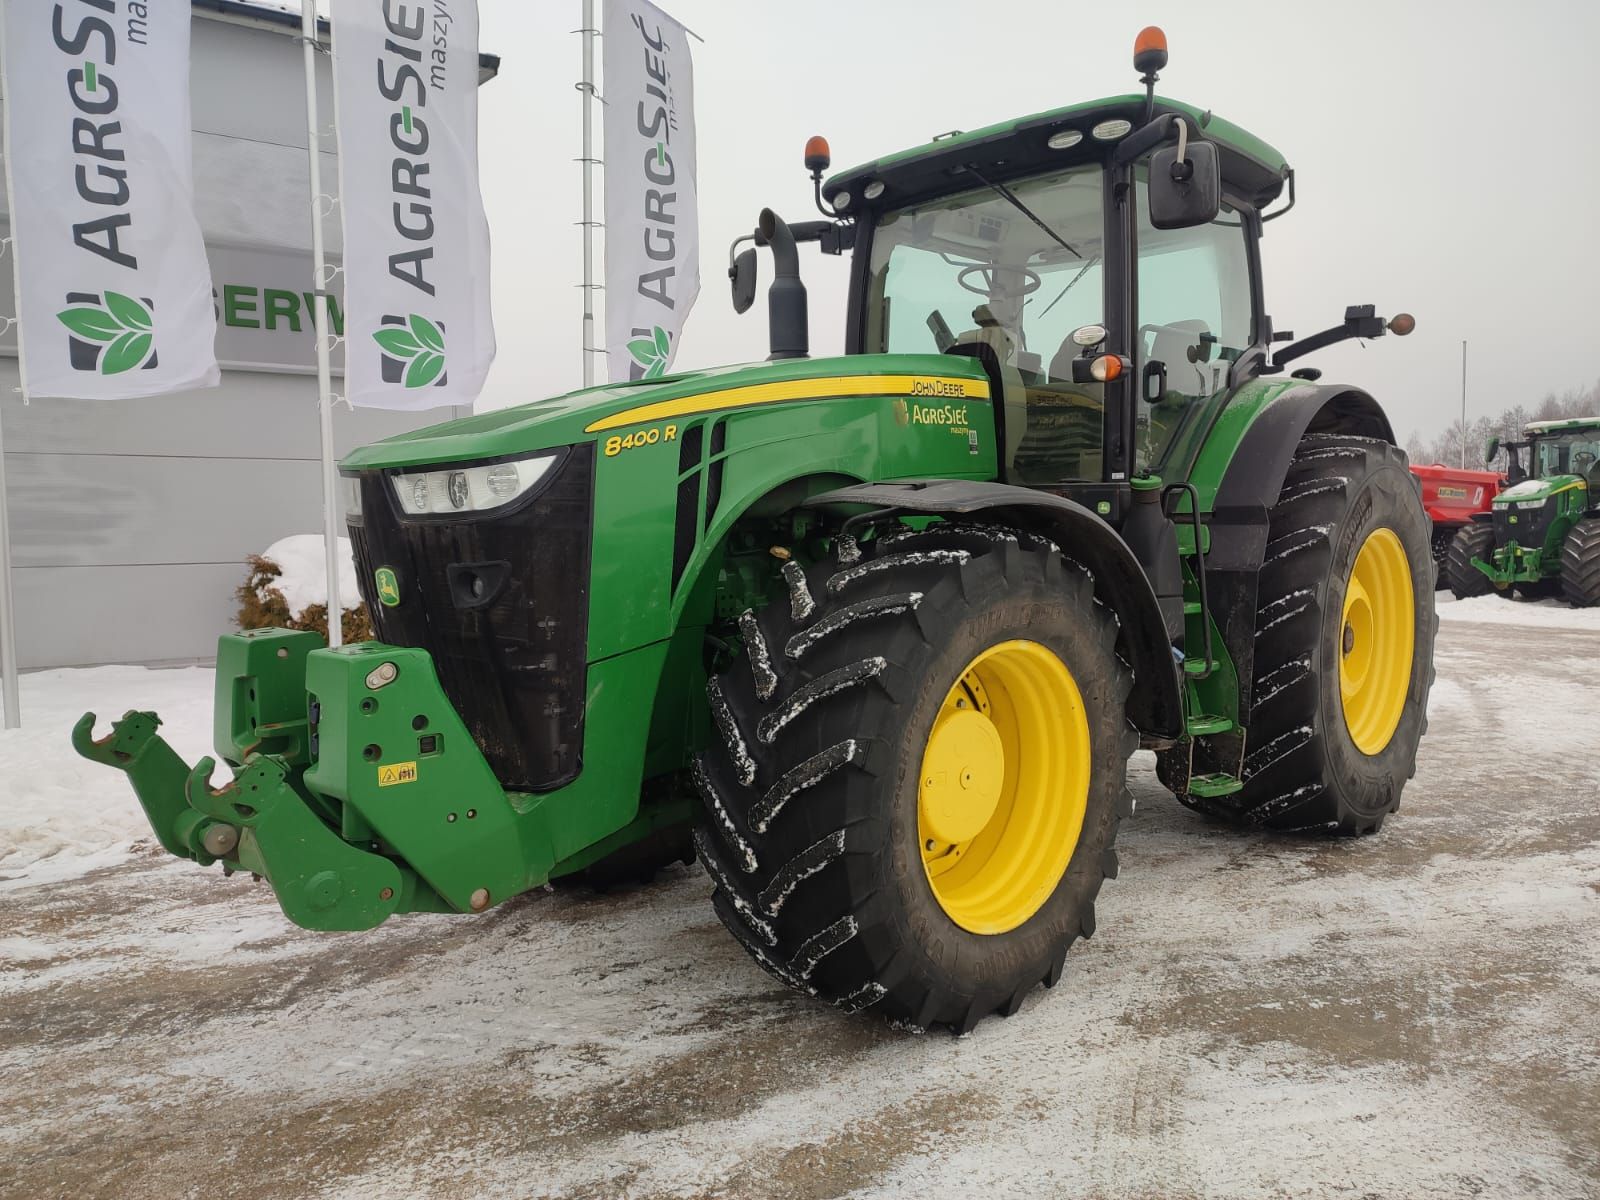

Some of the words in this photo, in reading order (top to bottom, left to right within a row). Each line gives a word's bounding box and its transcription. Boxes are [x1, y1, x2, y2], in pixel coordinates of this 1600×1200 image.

[128, 0, 148, 45] ma
[911, 379, 936, 396] JOHN
[936, 380, 965, 397] DEERE
[605, 428, 660, 457] 8400
[664, 424, 677, 442] R
